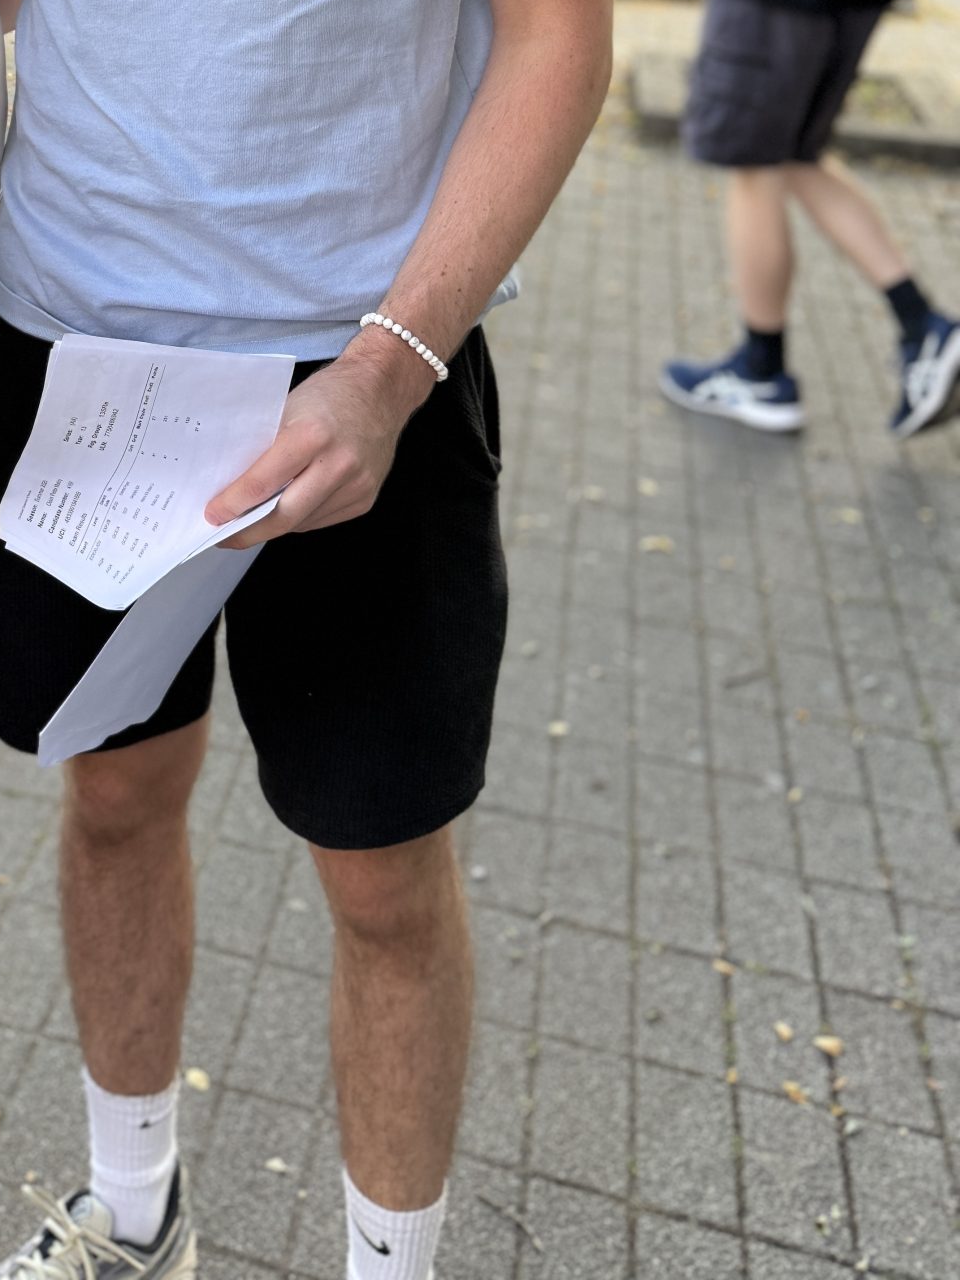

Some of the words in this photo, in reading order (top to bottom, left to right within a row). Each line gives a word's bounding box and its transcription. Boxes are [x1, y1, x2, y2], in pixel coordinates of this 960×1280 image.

[48, 509, 61, 534] Candidate
[69, 531, 80, 547] Exam
[76, 513, 88, 530] Results
